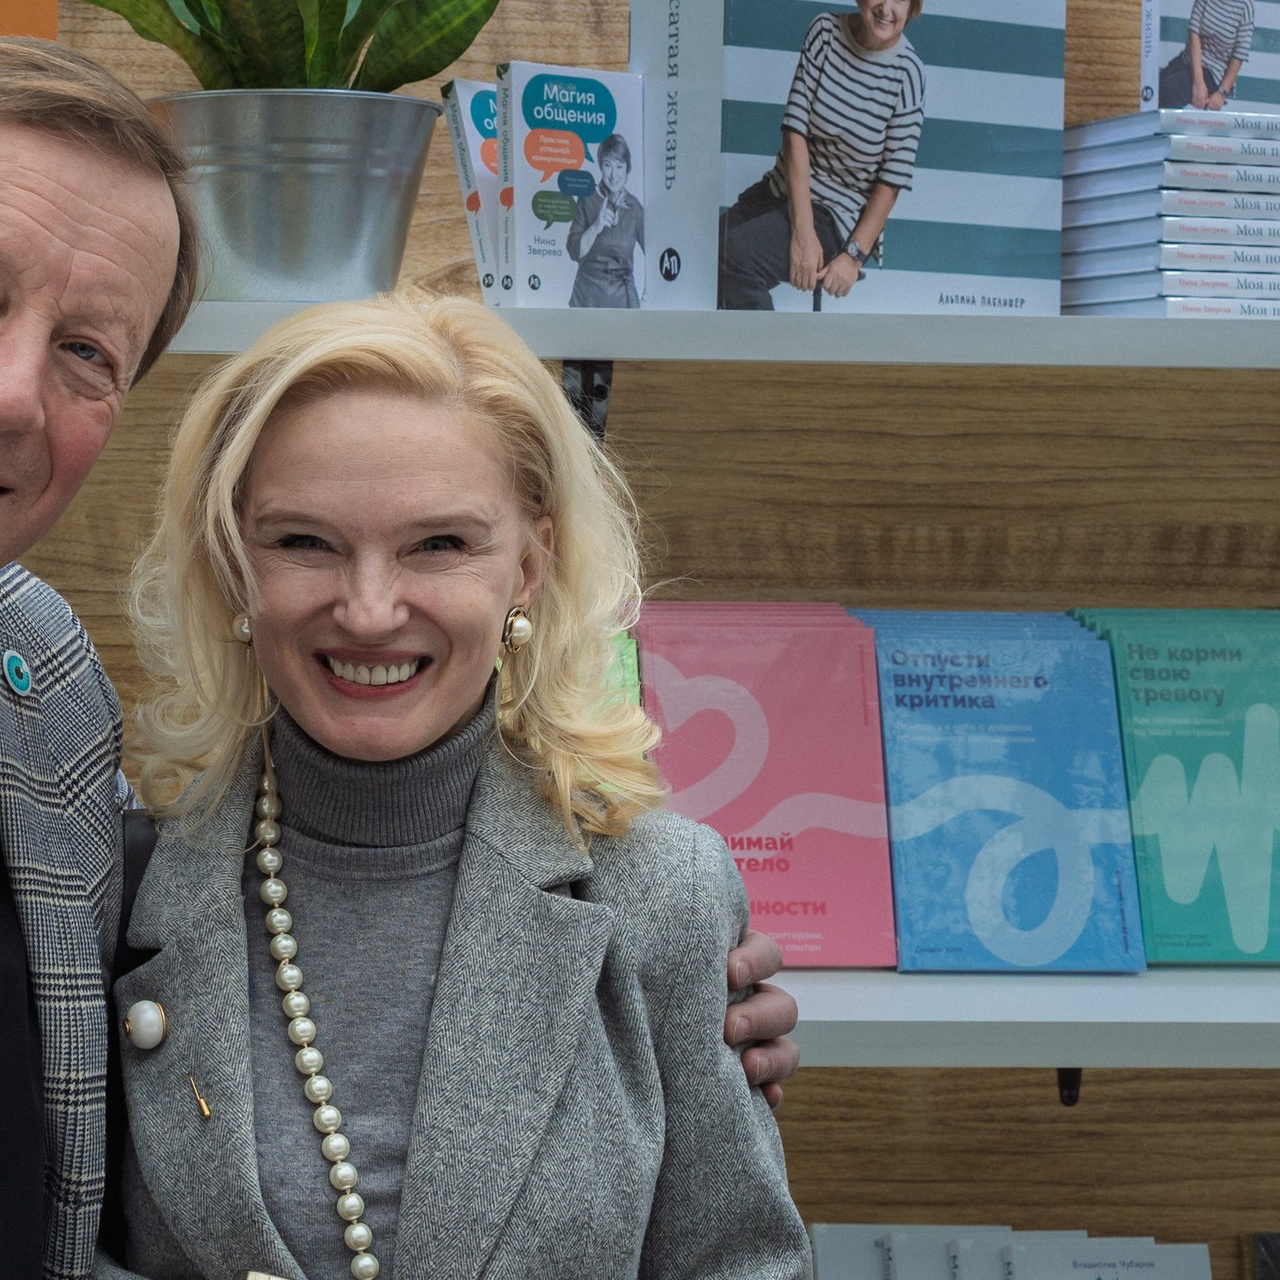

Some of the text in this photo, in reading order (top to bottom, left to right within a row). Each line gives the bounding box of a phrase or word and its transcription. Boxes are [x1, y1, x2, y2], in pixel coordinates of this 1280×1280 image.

[1143, 8, 1154, 58] жизнь
[543, 84, 596, 106] Магия
[533, 103, 606, 126] общения
[1234, 117, 1261, 130] Моя
[501, 87, 510, 183] Магия общения
[664, 90, 678, 191] жизнь
[1240, 143, 1267, 156] Моя
[1236, 170, 1263, 183] Моя
[1233, 197, 1260, 210] Моя
[1236, 224, 1263, 237] Моя
[533, 236, 556, 247] Нина
[527, 245, 563, 258] Зверева
[1233, 251, 1260, 264] Моя
[1237, 278, 1264, 291] Моя
[1240, 304, 1267, 317] Моя
[891, 649, 990, 673] Отпусти
[1126, 643, 1242, 666] Не корми
[1129, 667, 1192, 681] свою
[893, 674, 1049, 692] внутреннего
[895, 693, 996, 712] критика
[1131, 687, 1225, 707] тревогу
